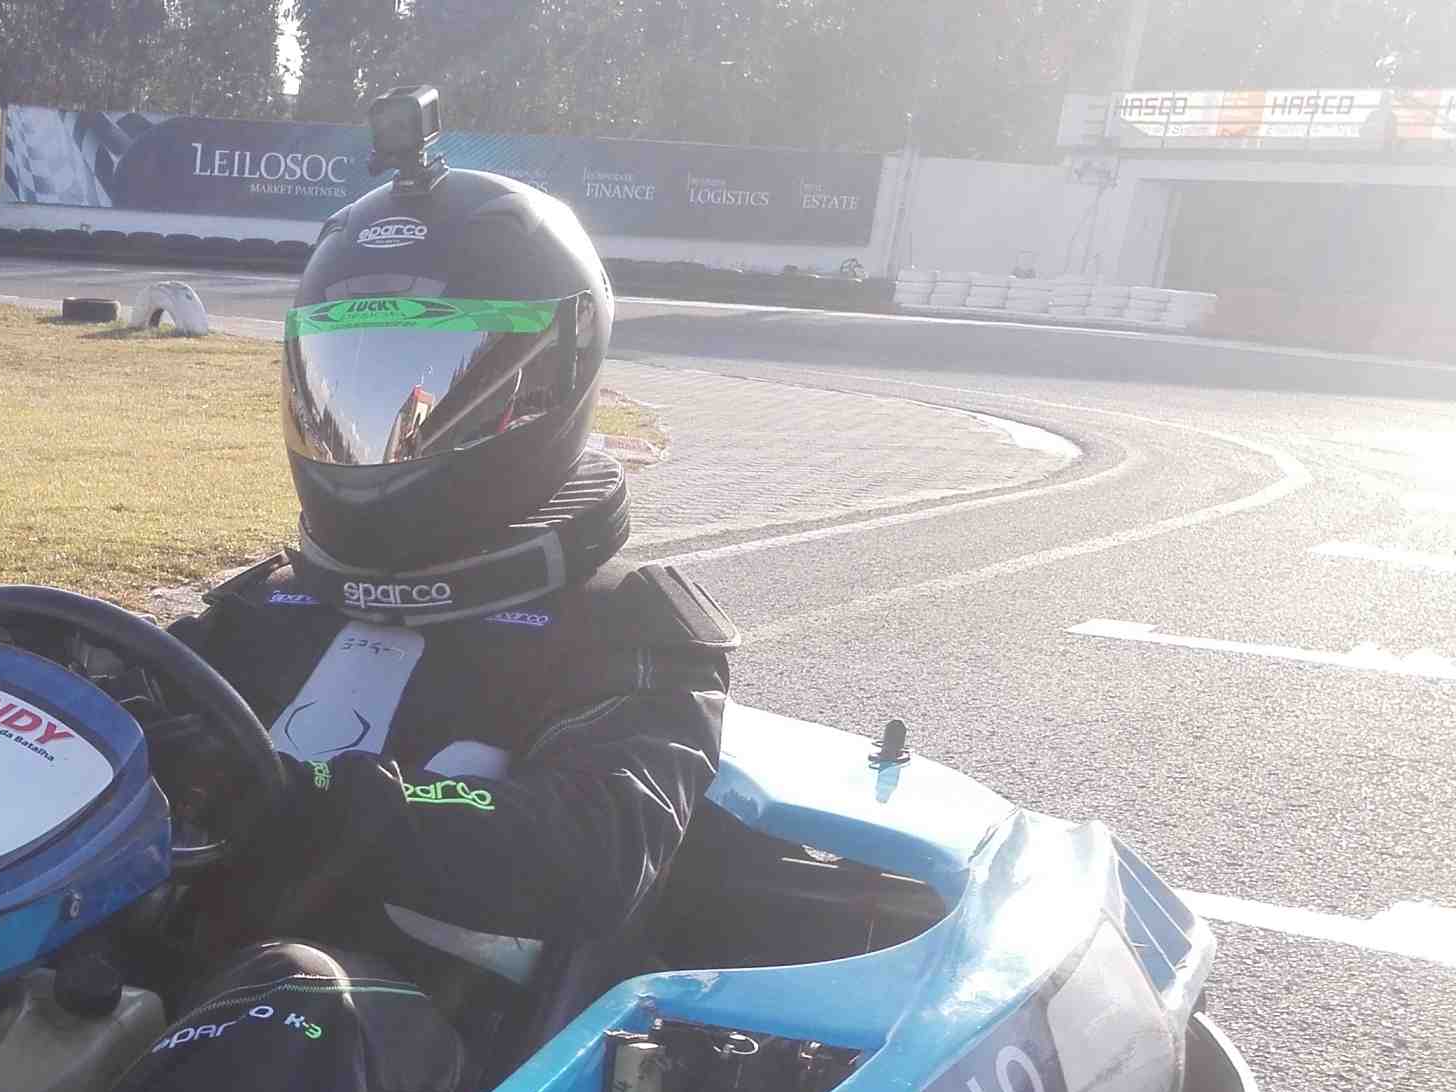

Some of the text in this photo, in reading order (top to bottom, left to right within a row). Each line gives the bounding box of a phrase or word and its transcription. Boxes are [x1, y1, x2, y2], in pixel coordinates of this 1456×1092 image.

[191, 143, 348, 183] LEILOSOC
[584, 183, 656, 200] FINANCE
[688, 189, 769, 207] LOGISTICS
[344, 582, 452, 609] sparco
[14, 735, 55, 762] Batalha
[403, 780, 493, 808] parco
